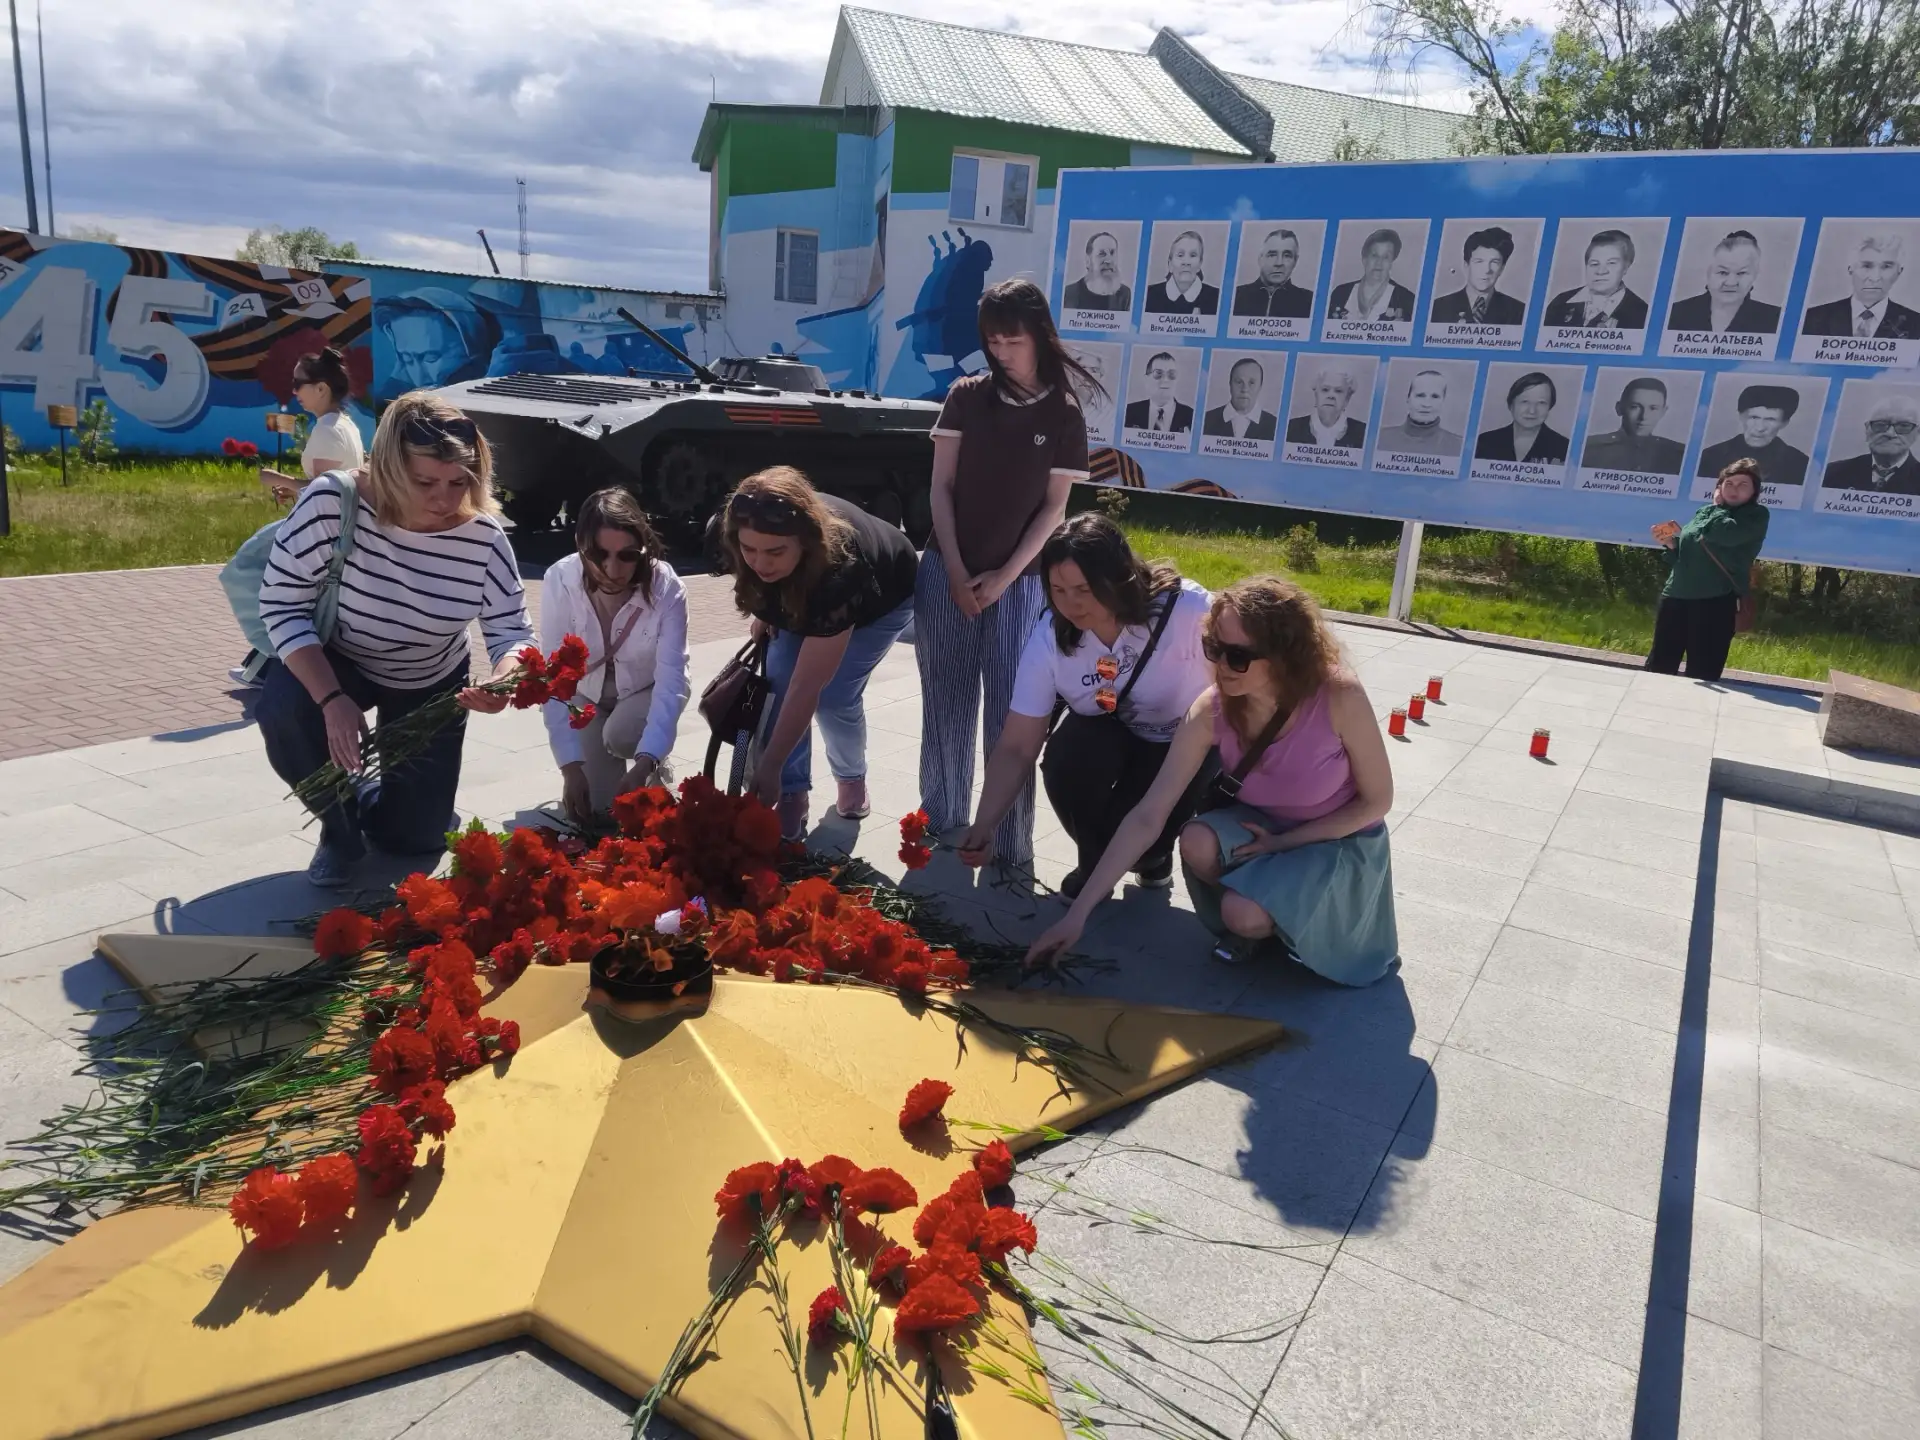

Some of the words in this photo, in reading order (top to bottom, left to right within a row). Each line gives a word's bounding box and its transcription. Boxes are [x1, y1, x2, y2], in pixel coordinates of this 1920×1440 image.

[297, 282, 322, 299] 09
[227, 298, 255, 316] 24
[1159, 315, 1200, 324] САИДОВА
[1248, 318, 1292, 327] МОРОЗОВ
[1341, 322, 1394, 332] СОРОКОВА
[1447, 325, 1502, 336] БУРЛАКОВ
[1557, 329, 1624, 340] БУРЛАКОВА
[1676, 333, 1763, 345] ВАСАЛАТЬЕВА
[0, 265, 210, 428] 45
[1821, 339, 1896, 351] ВОРОНЦОВ
[1216, 439, 1258, 449] НОВИКОВА
[1297, 445, 1350, 457] КОВШАКОВА
[1391, 454, 1441, 465] КОЗИЦЫНА
[1489, 463, 1545, 474] КОМАРОВА
[1594, 472, 1665, 485] КРИВОБОКОВ
[1840, 492, 1913, 507] МАССАРОВ
